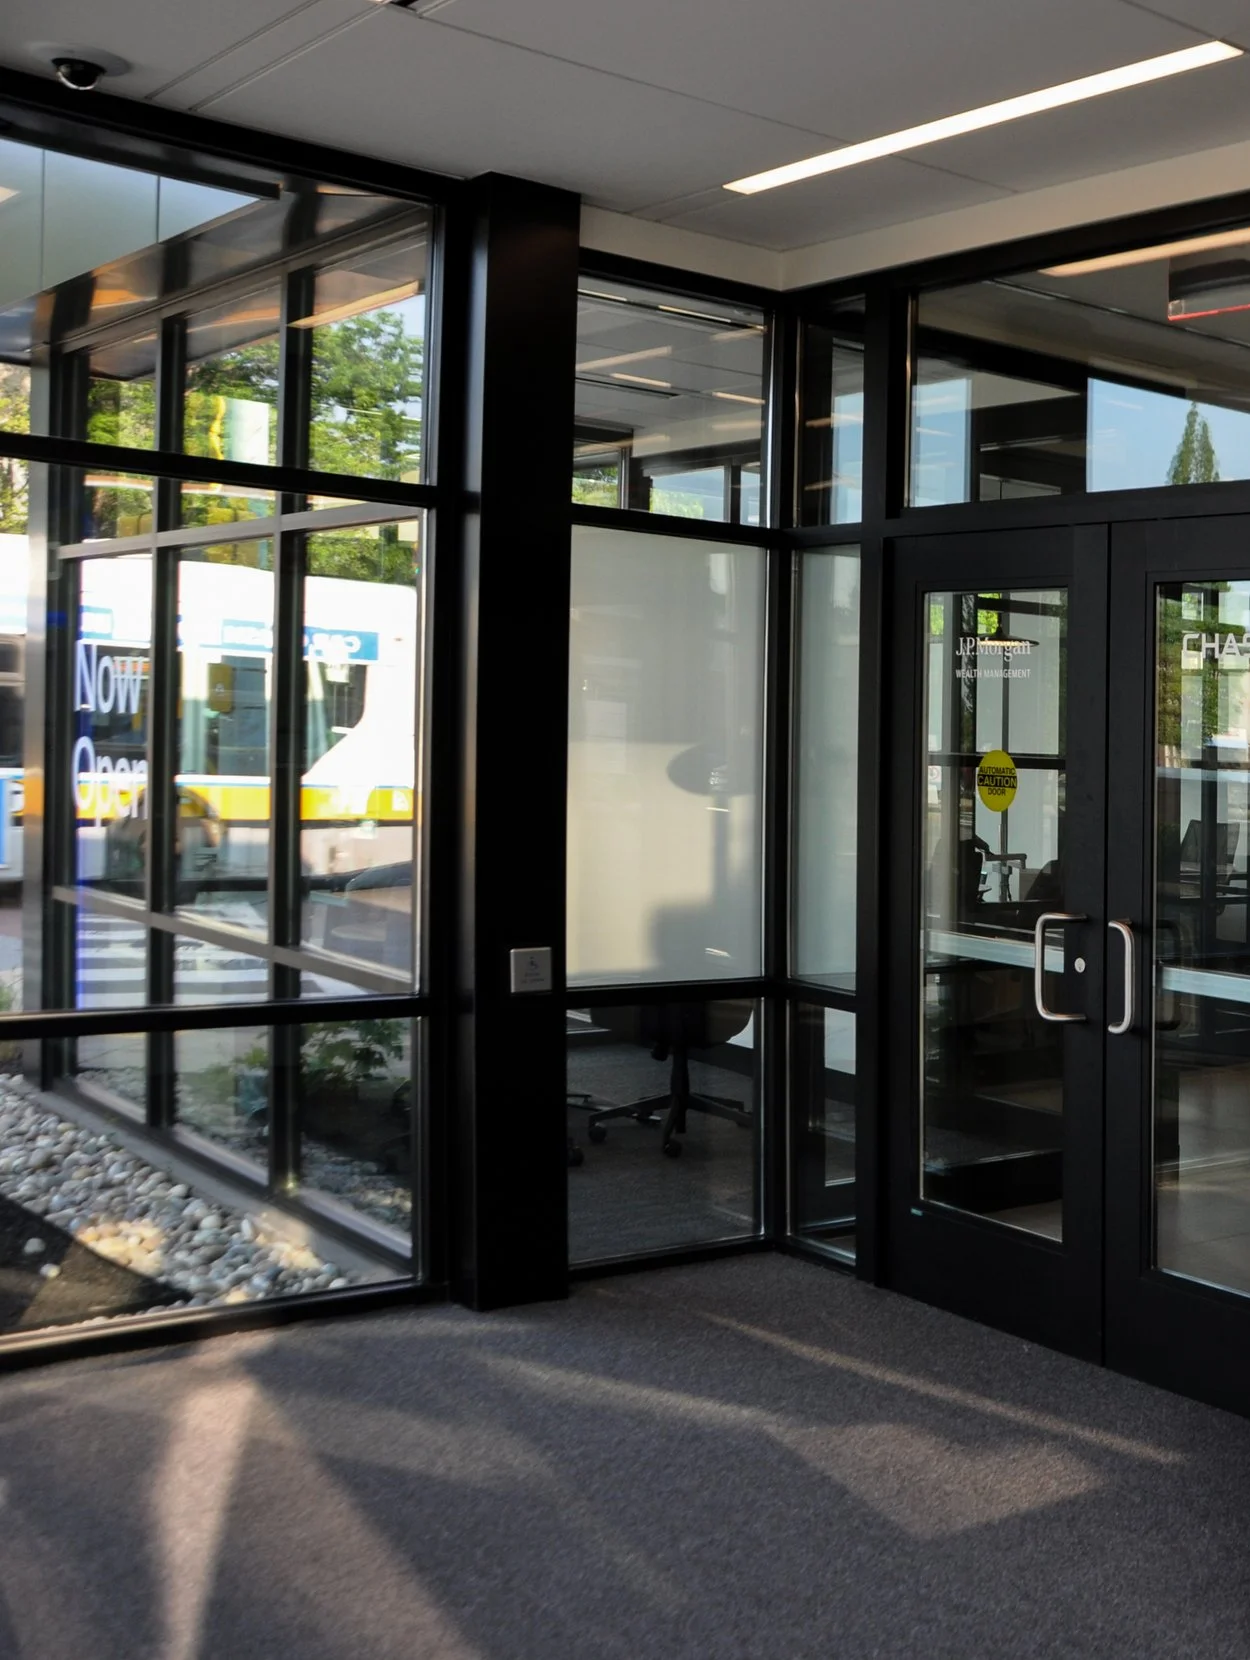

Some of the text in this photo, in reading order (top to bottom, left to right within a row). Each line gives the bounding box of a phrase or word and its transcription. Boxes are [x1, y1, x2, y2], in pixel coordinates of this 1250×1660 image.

[956, 637, 1031, 661] J.P.Morgan
[74, 643, 143, 713] Now
[956, 668, 1031, 679] WEALTH MANAGEMENT
[980, 766, 1015, 775] AUTOMATIC
[72, 735, 148, 827] Open
[978, 775, 1016, 787] CAUTION
[987, 788, 1006, 796] DOOR
